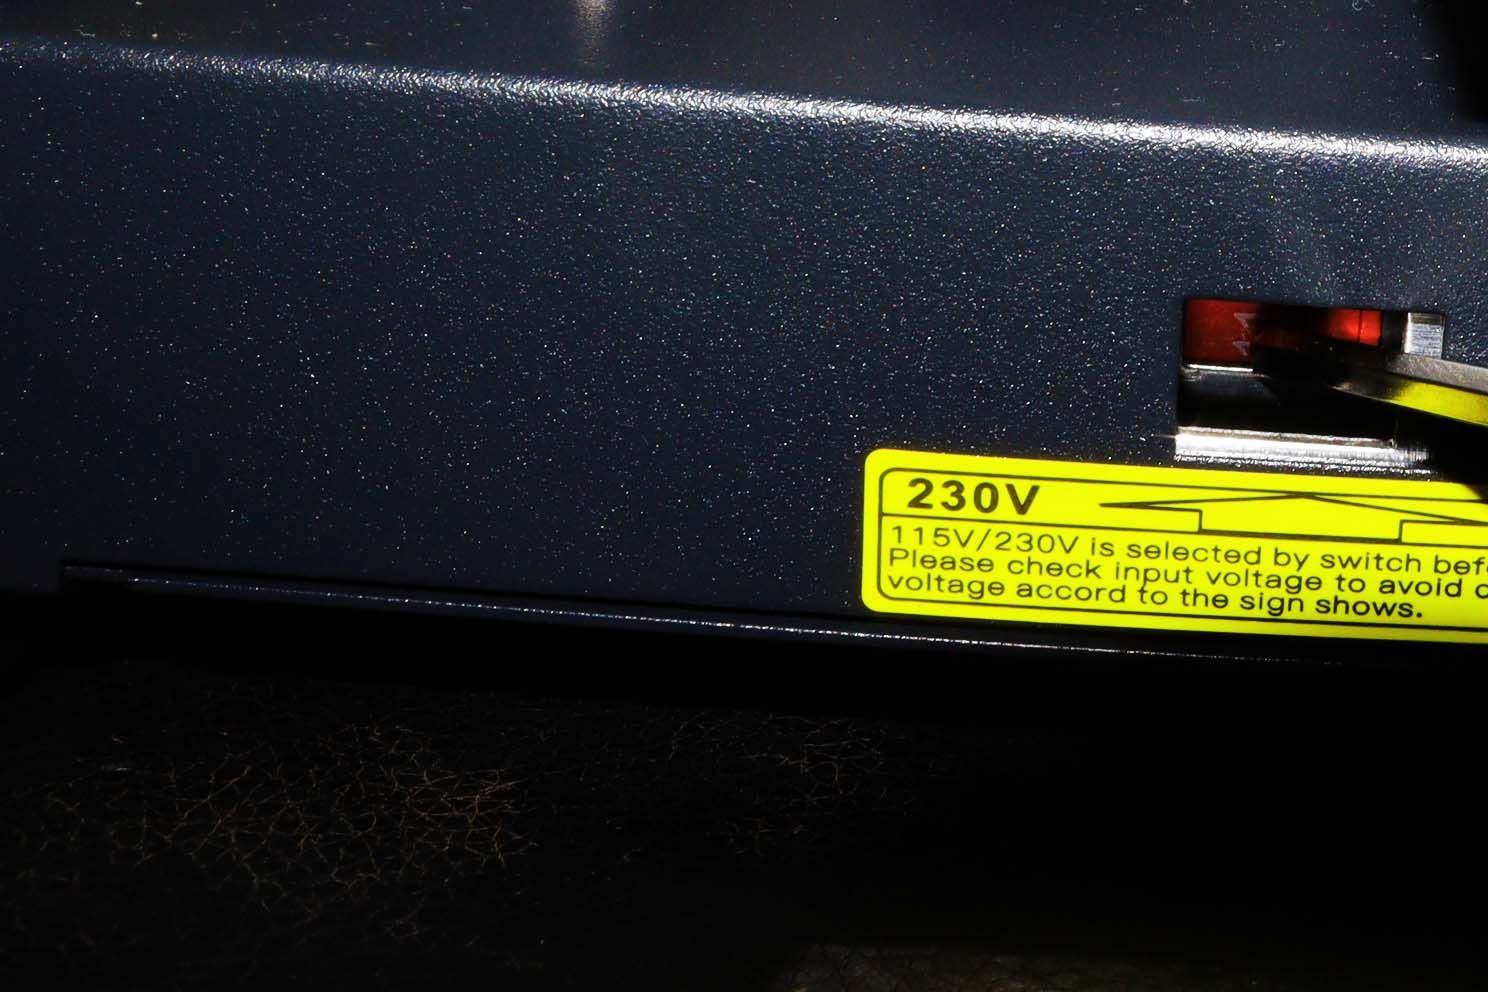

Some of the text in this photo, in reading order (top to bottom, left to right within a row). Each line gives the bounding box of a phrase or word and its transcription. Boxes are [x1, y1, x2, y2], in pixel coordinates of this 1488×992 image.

[907, 477, 1040, 516] 230V
[889, 547, 995, 573] Please
[1007, 557, 1102, 580] check
[1115, 561, 1193, 590] input
[1206, 567, 1323, 595] voltage
[1335, 573, 1367, 594] to
[1378, 578, 1462, 599] avoid
[891, 525, 1079, 555] 115V/230V
[1090, 537, 1115, 558] is
[1126, 540, 1262, 566] selected
[1273, 547, 1311, 571] by
[1320, 553, 1422, 574] switch
[887, 573, 1424, 619] voltage accord to the sign shows.
